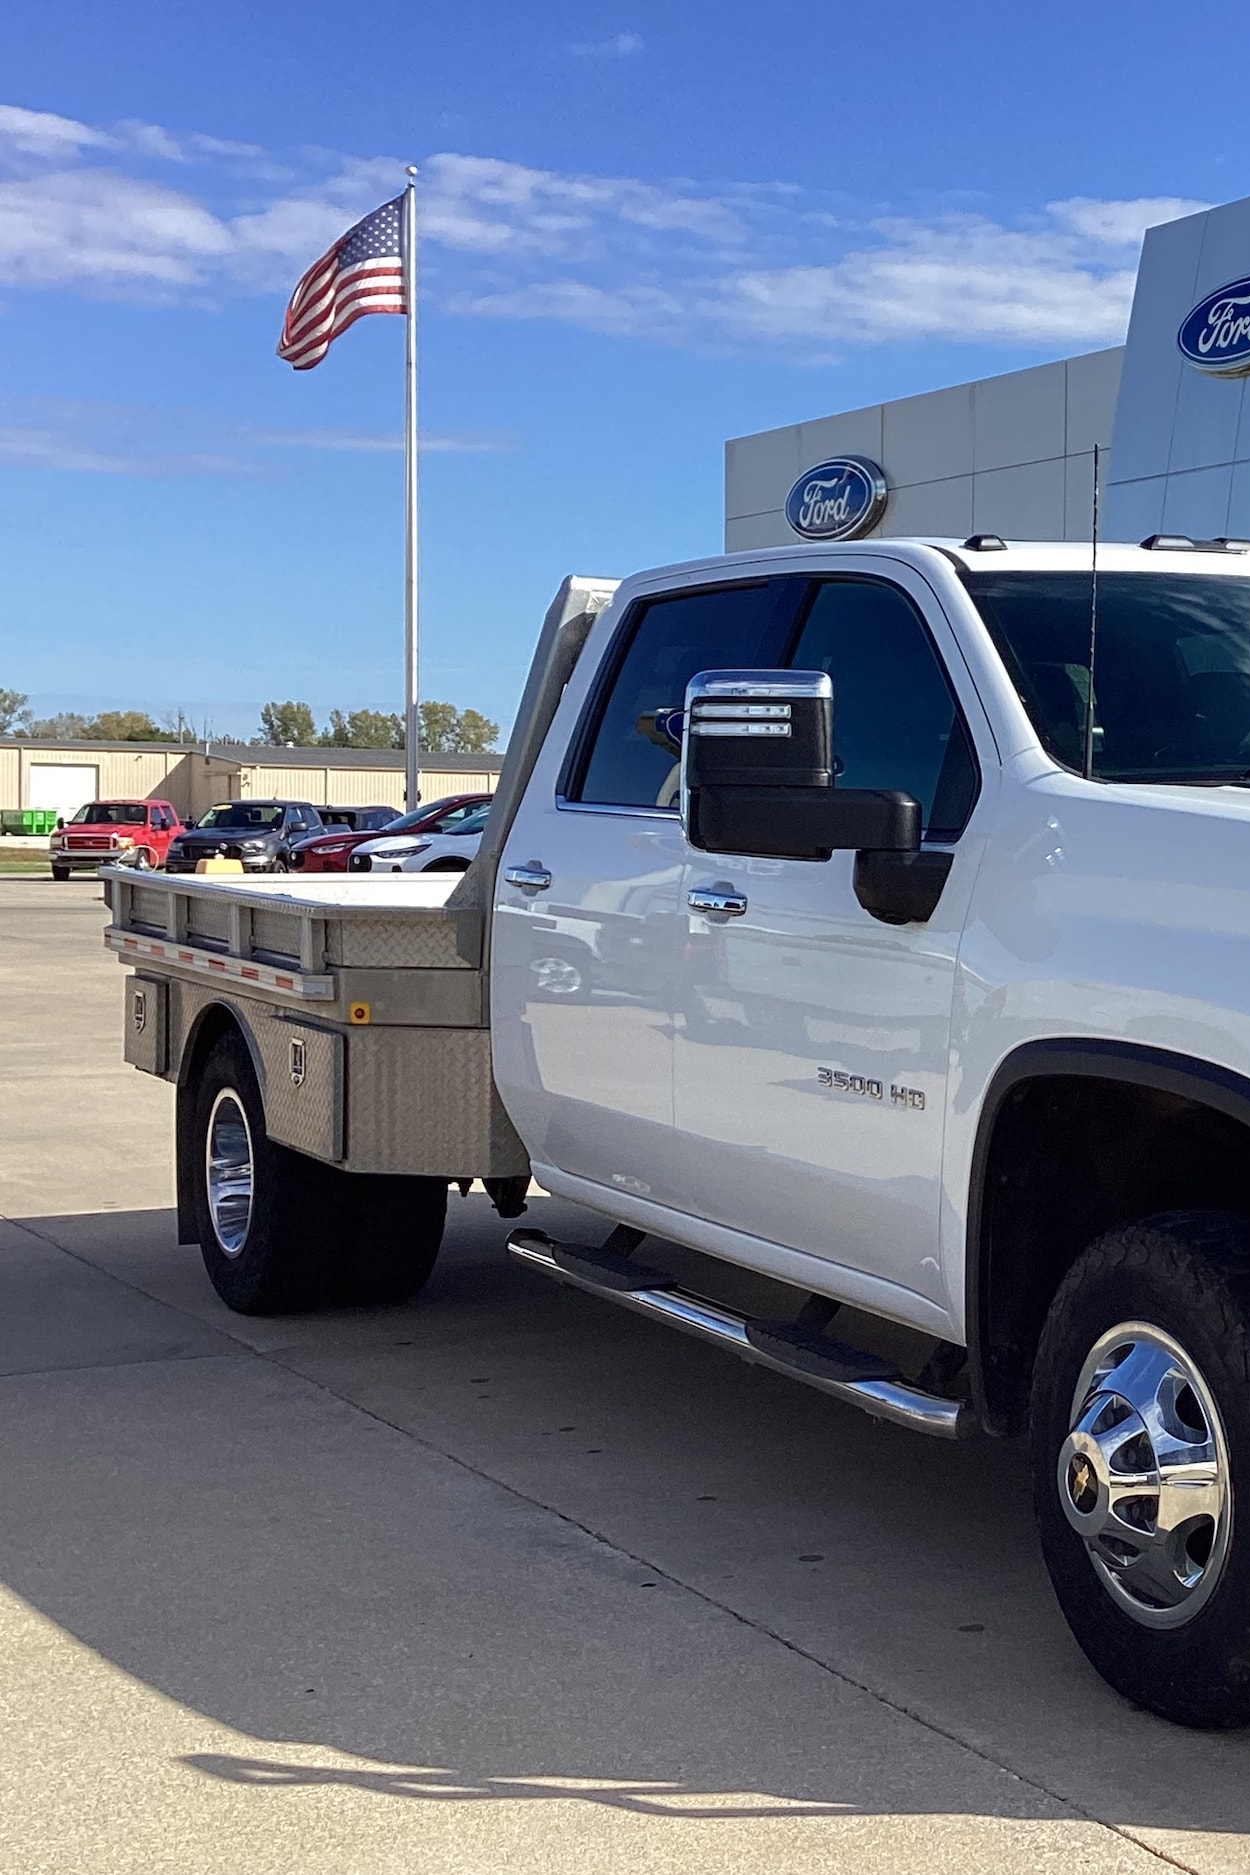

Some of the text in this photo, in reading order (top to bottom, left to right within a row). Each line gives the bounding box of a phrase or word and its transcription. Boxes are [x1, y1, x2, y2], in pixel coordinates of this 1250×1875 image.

[799, 478, 851, 528] Ford
[817, 1066, 925, 1111] 3500 HD
